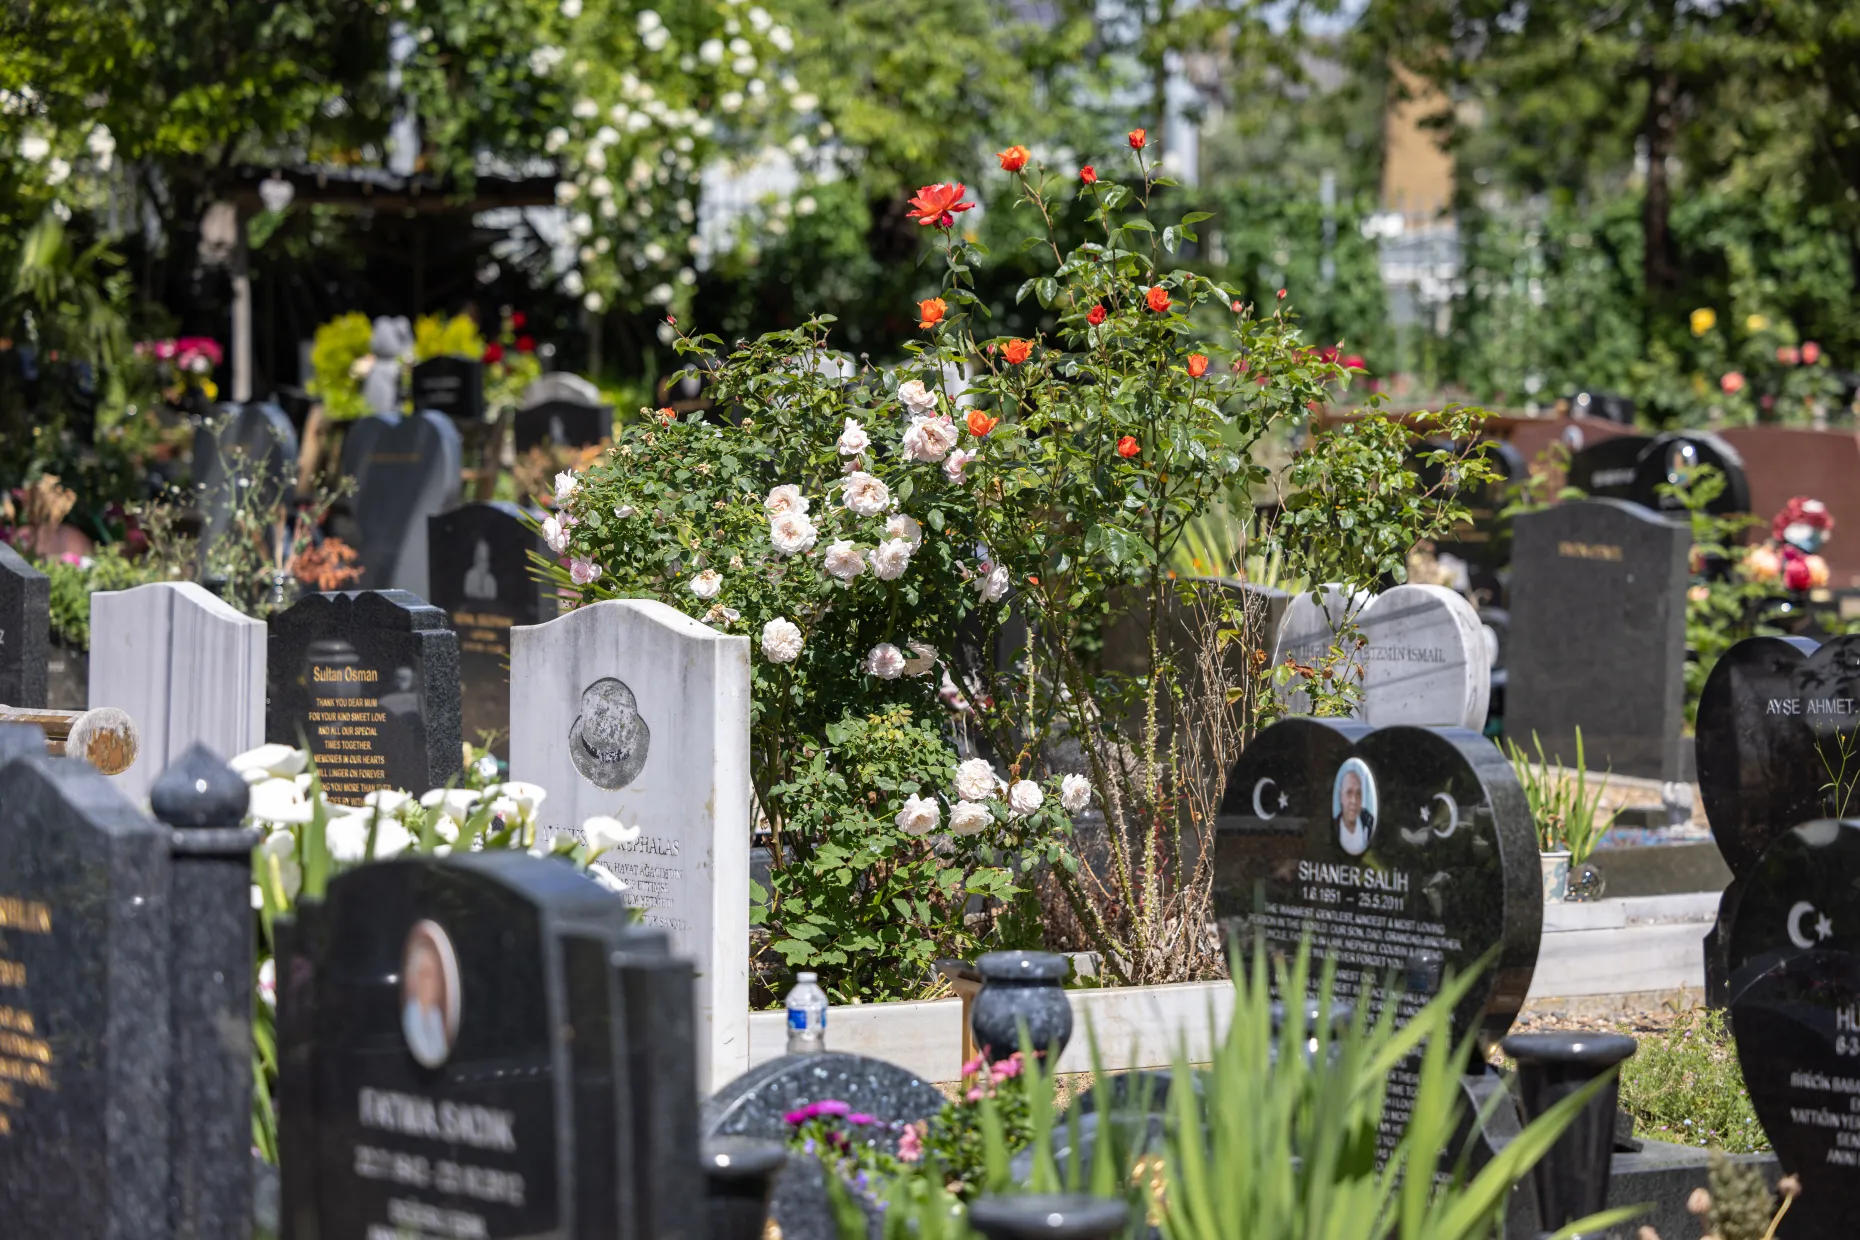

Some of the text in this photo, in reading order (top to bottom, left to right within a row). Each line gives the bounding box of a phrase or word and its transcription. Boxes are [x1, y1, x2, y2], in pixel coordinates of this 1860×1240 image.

[314, 666, 378, 682] Sultan Osman
[316, 698, 378, 707] THANK YOU DEAR MUM
[1807, 698, 1854, 714] AHMET
[308, 712, 386, 722] FOR YOUR KIND SWEET LOVE
[318, 726, 378, 736] AND ALL OUR SPECIAL
[325, 740, 340, 749] TIMES
[314, 754, 385, 764] MEMORIES IN OUR HEARTS
[329, 769, 348, 778] LINGER
[349, 769, 358, 778] ON
[359, 769, 385, 778] FOREVER
[331, 782, 342, 791] YOU
[344, 783, 359, 792] MORE
[360, 784, 375, 792] THAN
[1298, 860, 1409, 892] SHANER SALİH
[1303, 886, 1341, 903] 1.6.1951
[1358, 891, 1404, 911] 25.5.2011
[1416, 921, 1446, 936] LOVING
